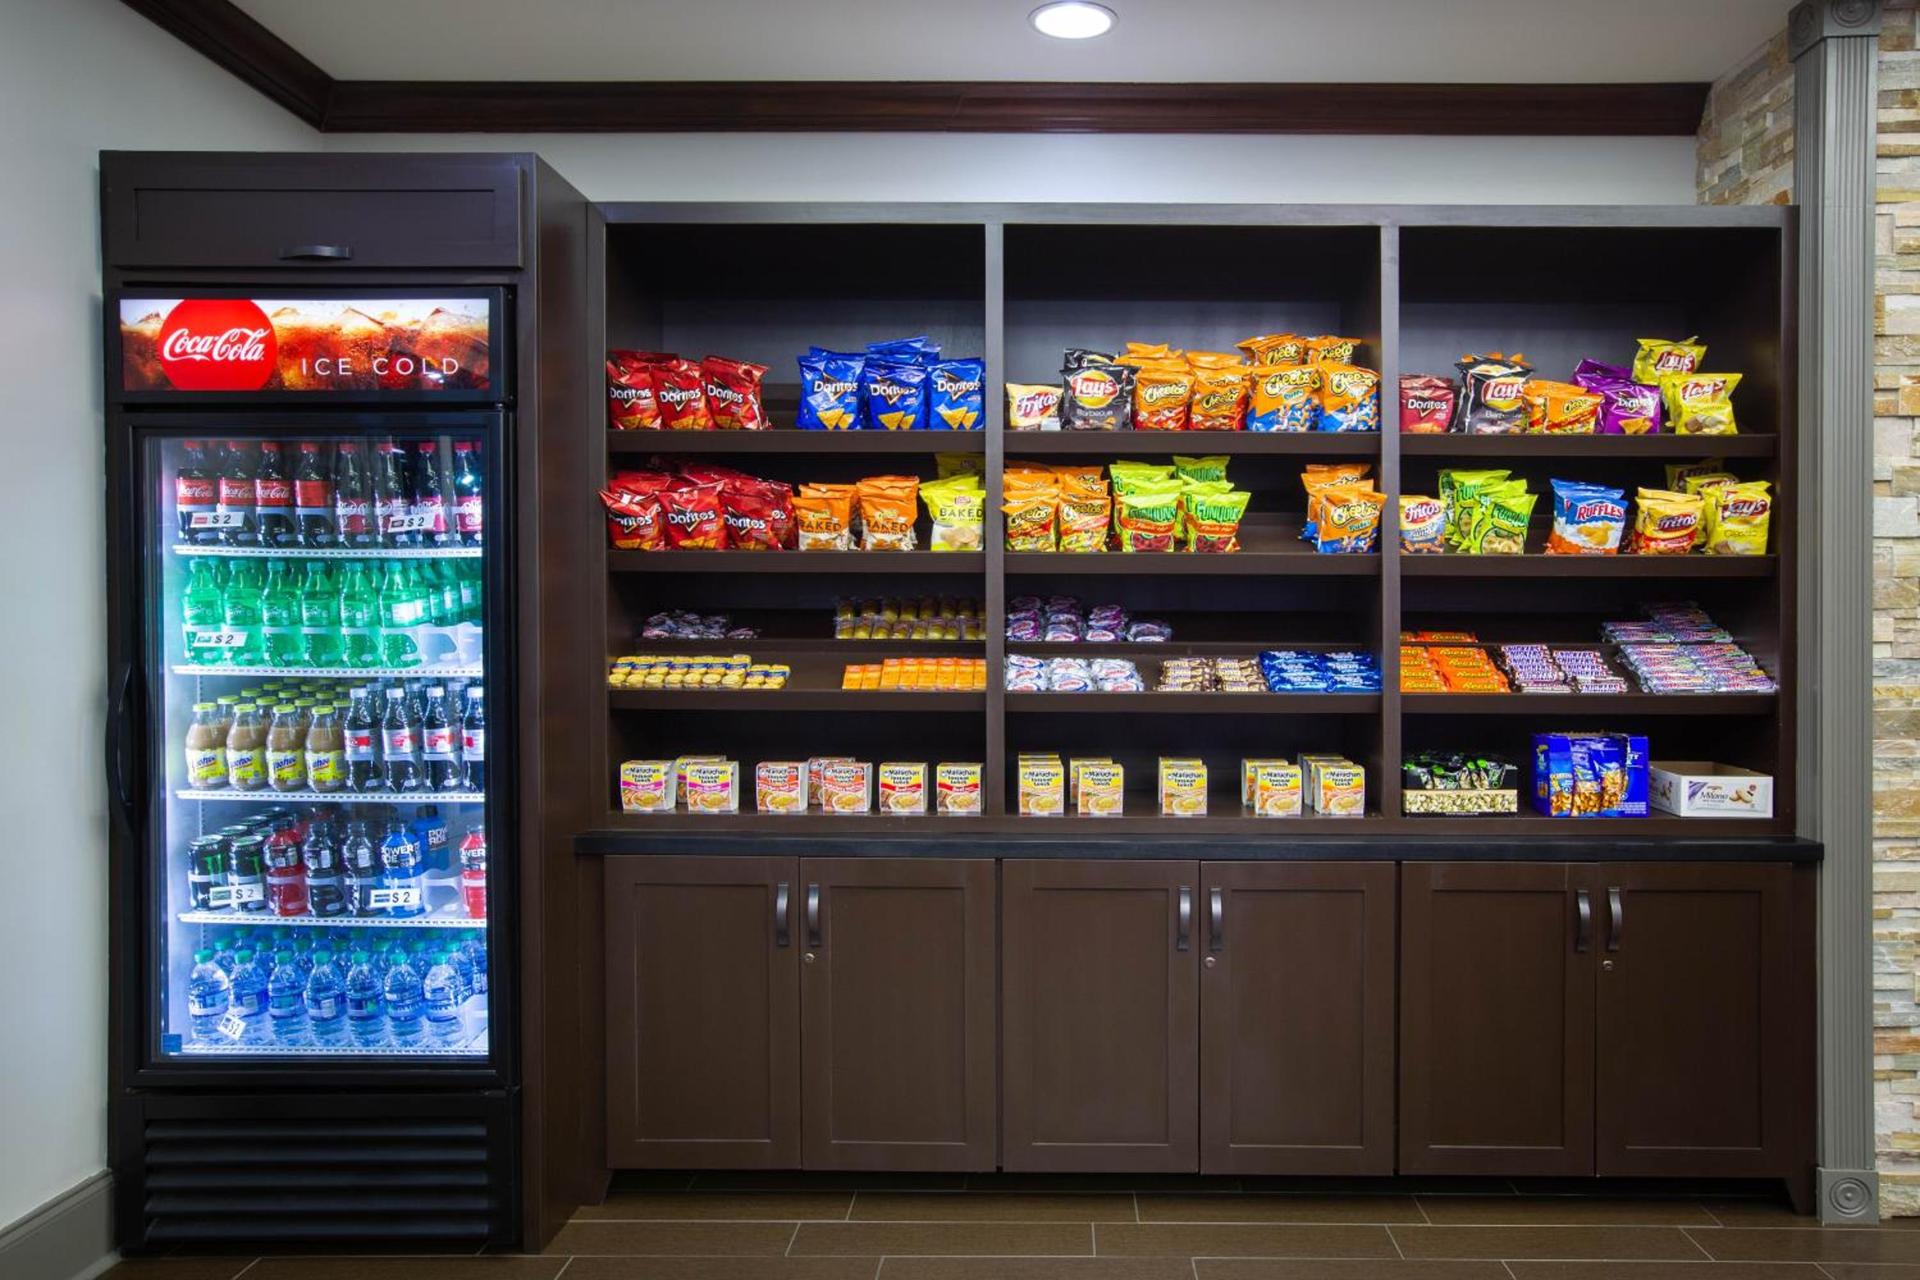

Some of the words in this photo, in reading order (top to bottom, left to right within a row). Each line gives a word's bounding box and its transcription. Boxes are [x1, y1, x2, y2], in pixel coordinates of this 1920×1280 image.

[163, 327, 269, 362] Coca-Cola
[302, 358, 352, 376] ICE
[373, 358, 460, 376] COLD
[610, 387, 652, 398] Doritos
[814, 380, 858, 393] Doritos
[937, 380, 981, 392] Doritos
[1144, 383, 1188, 403] Cheetos
[659, 389, 700, 402] Doritos
[707, 385, 743, 403] Doritos
[1408, 399, 1447, 409] Doritos
[668, 509, 715, 524] Doritos
[940, 508, 984, 518] BAKED
[1406, 502, 1440, 521] Fritos
[1576, 502, 1625, 521] RUFFLES
[724, 514, 766, 529] Doritos
[1657, 512, 1697, 529] Fritos
